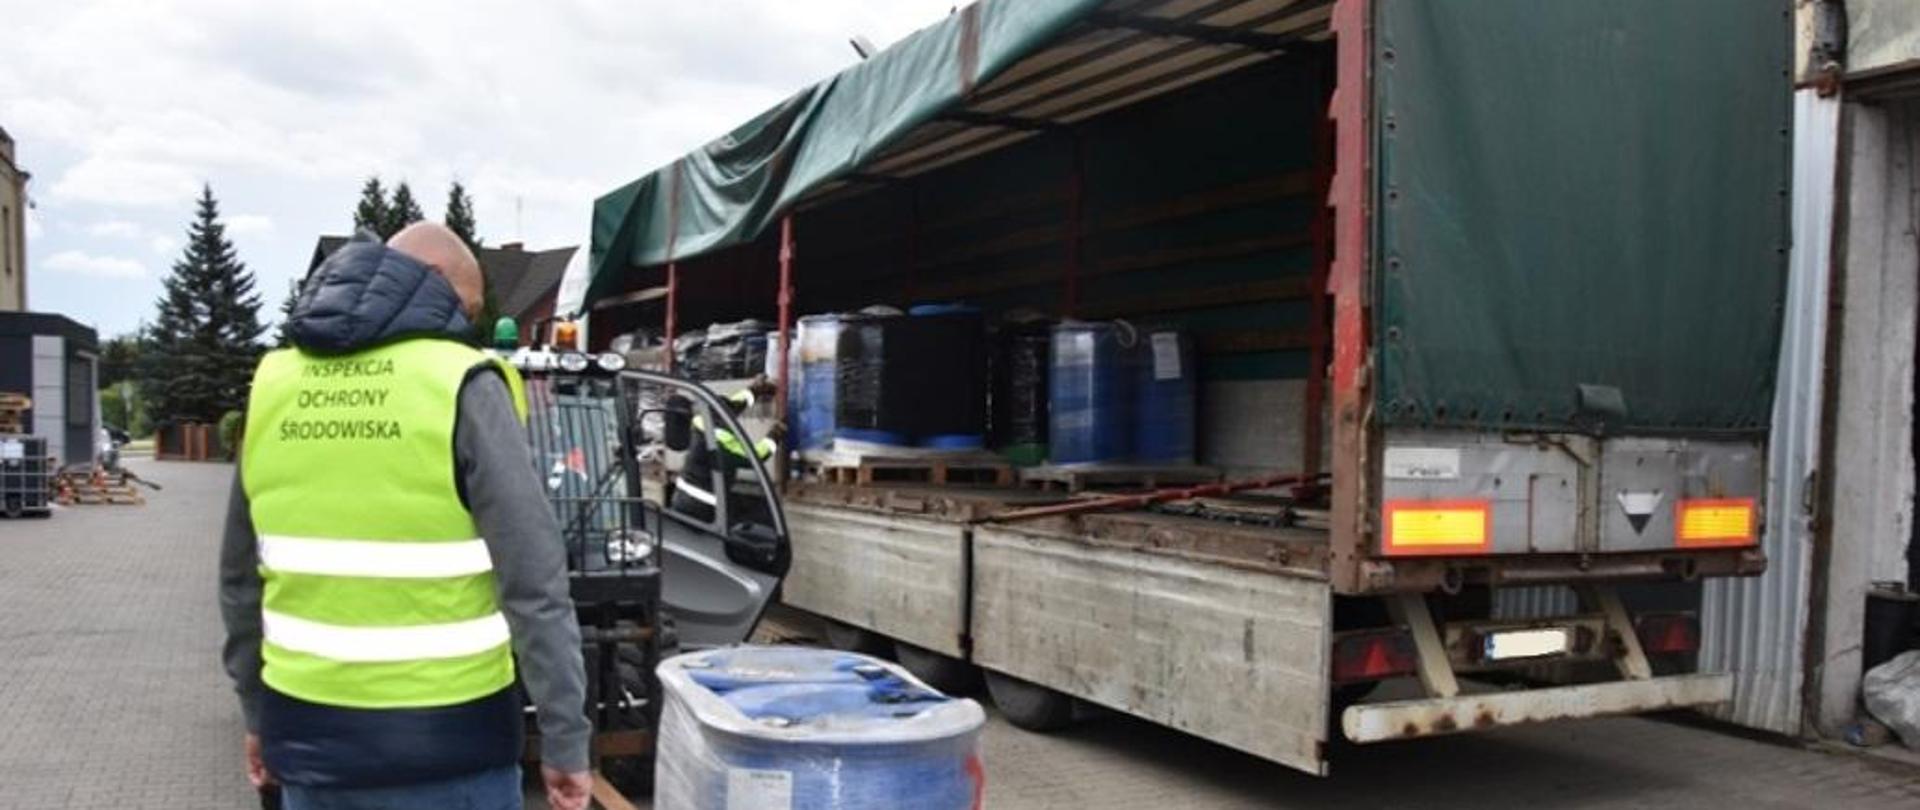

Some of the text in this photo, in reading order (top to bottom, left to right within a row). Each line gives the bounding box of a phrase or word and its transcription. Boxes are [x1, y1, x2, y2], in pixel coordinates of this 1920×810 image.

[302, 358, 394, 378] INSPEKCJA
[298, 388, 389, 409] OCHRONY
[280, 417, 401, 440] ŚRODOWISKA
